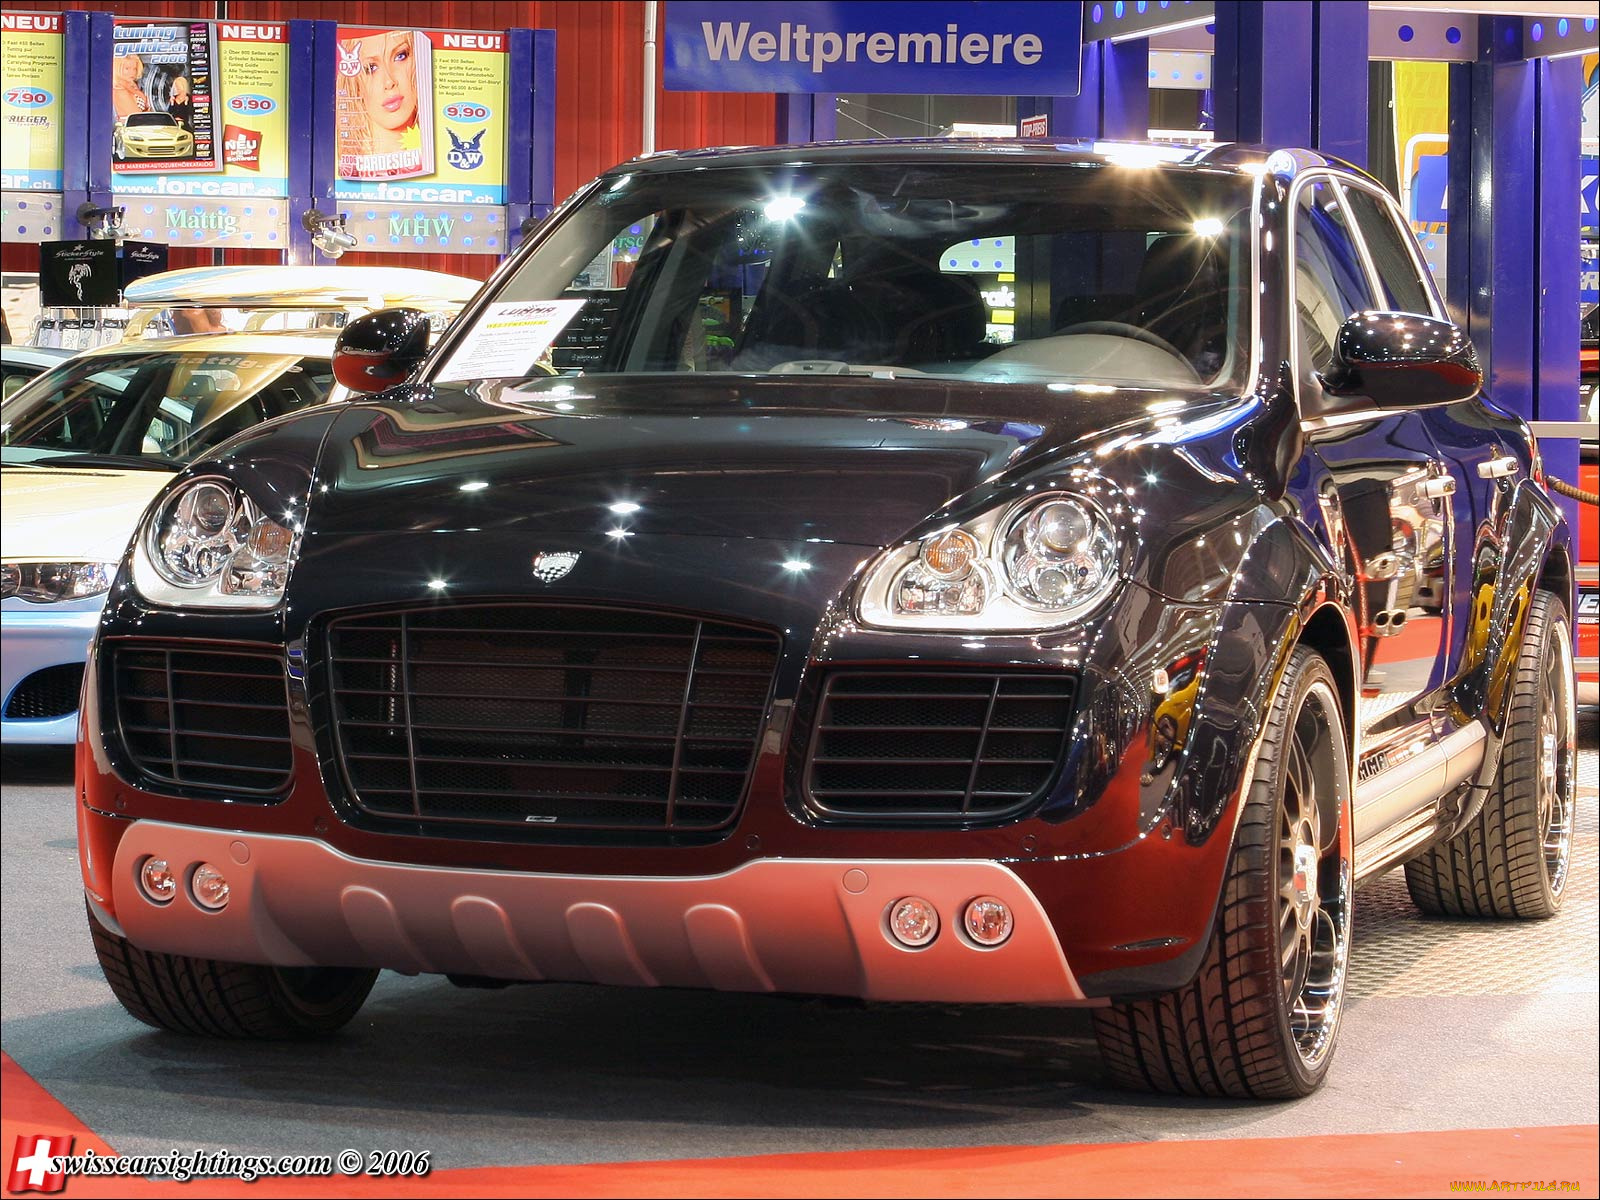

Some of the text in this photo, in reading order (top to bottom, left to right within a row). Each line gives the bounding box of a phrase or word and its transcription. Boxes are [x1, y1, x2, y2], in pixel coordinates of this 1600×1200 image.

[1, 15, 58, 31] NEU!
[113, 24, 177, 41] tuning
[222, 24, 282, 40] NEU!
[114, 38, 189, 58] guide.ch
[443, 33, 502, 49] NEU!
[702, 21, 1043, 73] Weltpremiere
[150, 54, 188, 64] 2006
[7, 92, 47, 105] 7,90
[231, 99, 272, 111] 9,90
[8, 114, 48, 124] RIEGER
[447, 106, 487, 118] 9,90
[225, 139, 257, 150] NEU
[356, 149, 420, 172] CARDESIGN
[449, 151, 483, 169] D&W
[112, 176, 278, 195] www.forcar.ch
[335, 183, 494, 204] www.forcar.ch
[164, 208, 239, 234] Mattig
[388, 217, 455, 237] MHW
